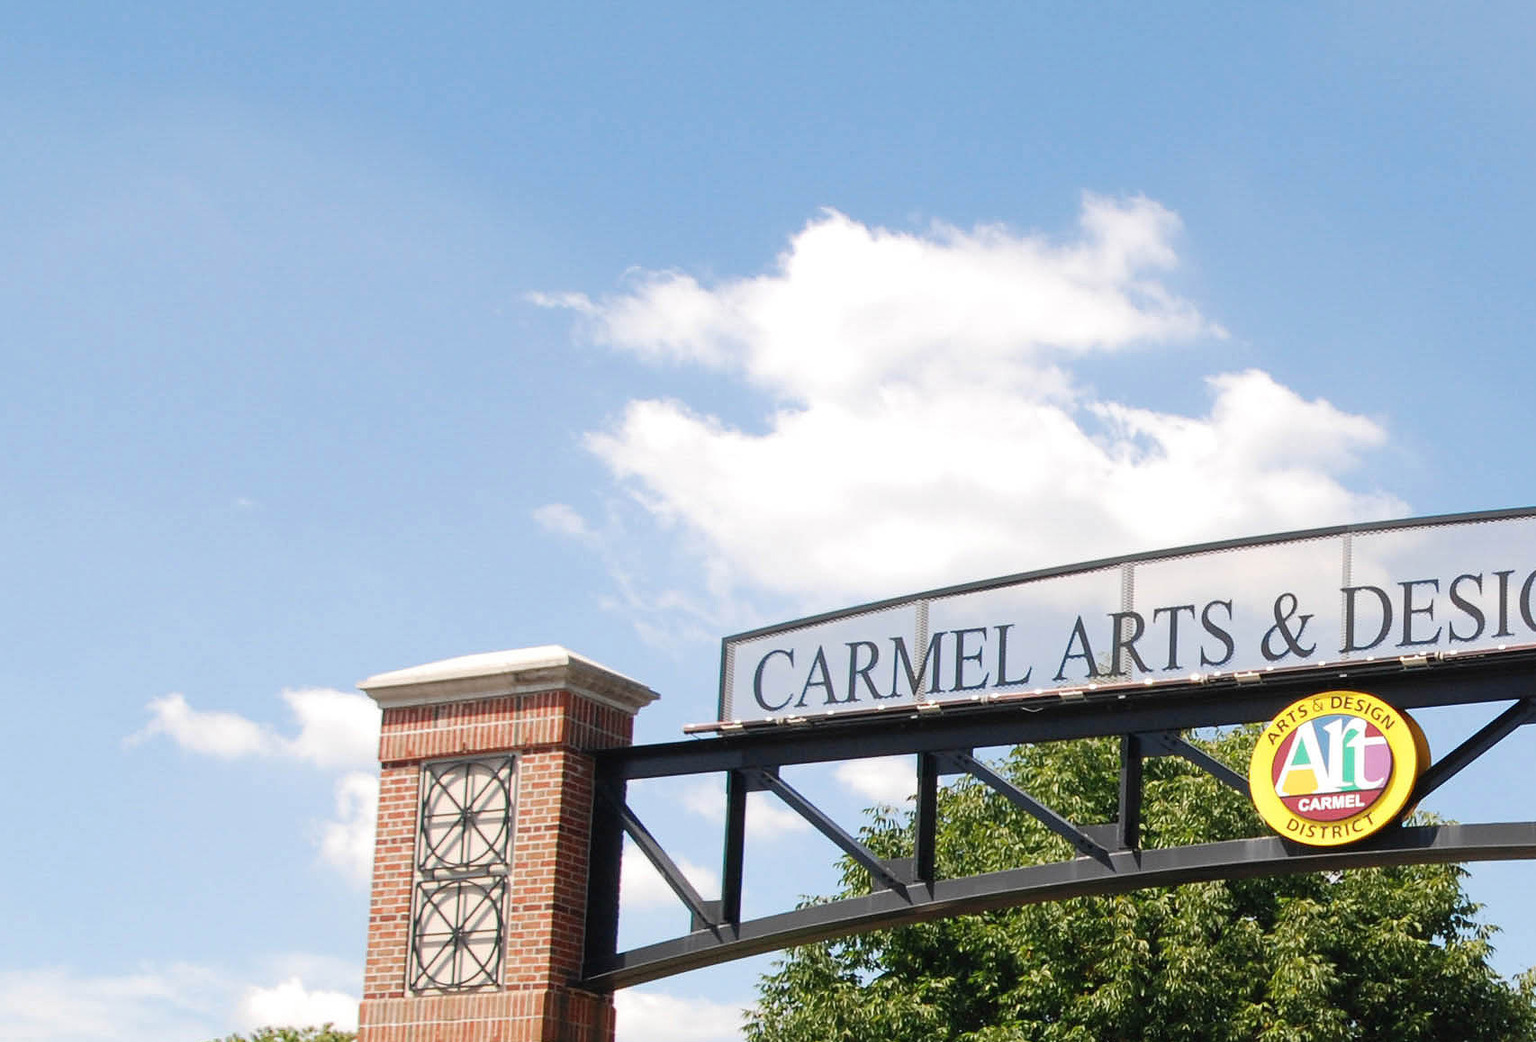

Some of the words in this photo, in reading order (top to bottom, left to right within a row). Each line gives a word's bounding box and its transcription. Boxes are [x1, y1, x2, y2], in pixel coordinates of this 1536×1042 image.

[753, 624, 1032, 712] CARMEL
[1052, 599, 1234, 682] ARTS
[1260, 592, 1317, 663] &
[1267, 704, 1308, 746] ARTS
[1312, 698, 1324, 713] &
[1330, 696, 1396, 730] DESIGN
[1298, 794, 1366, 812] CARMEL
[1286, 812, 1376, 839] DISTRICT
